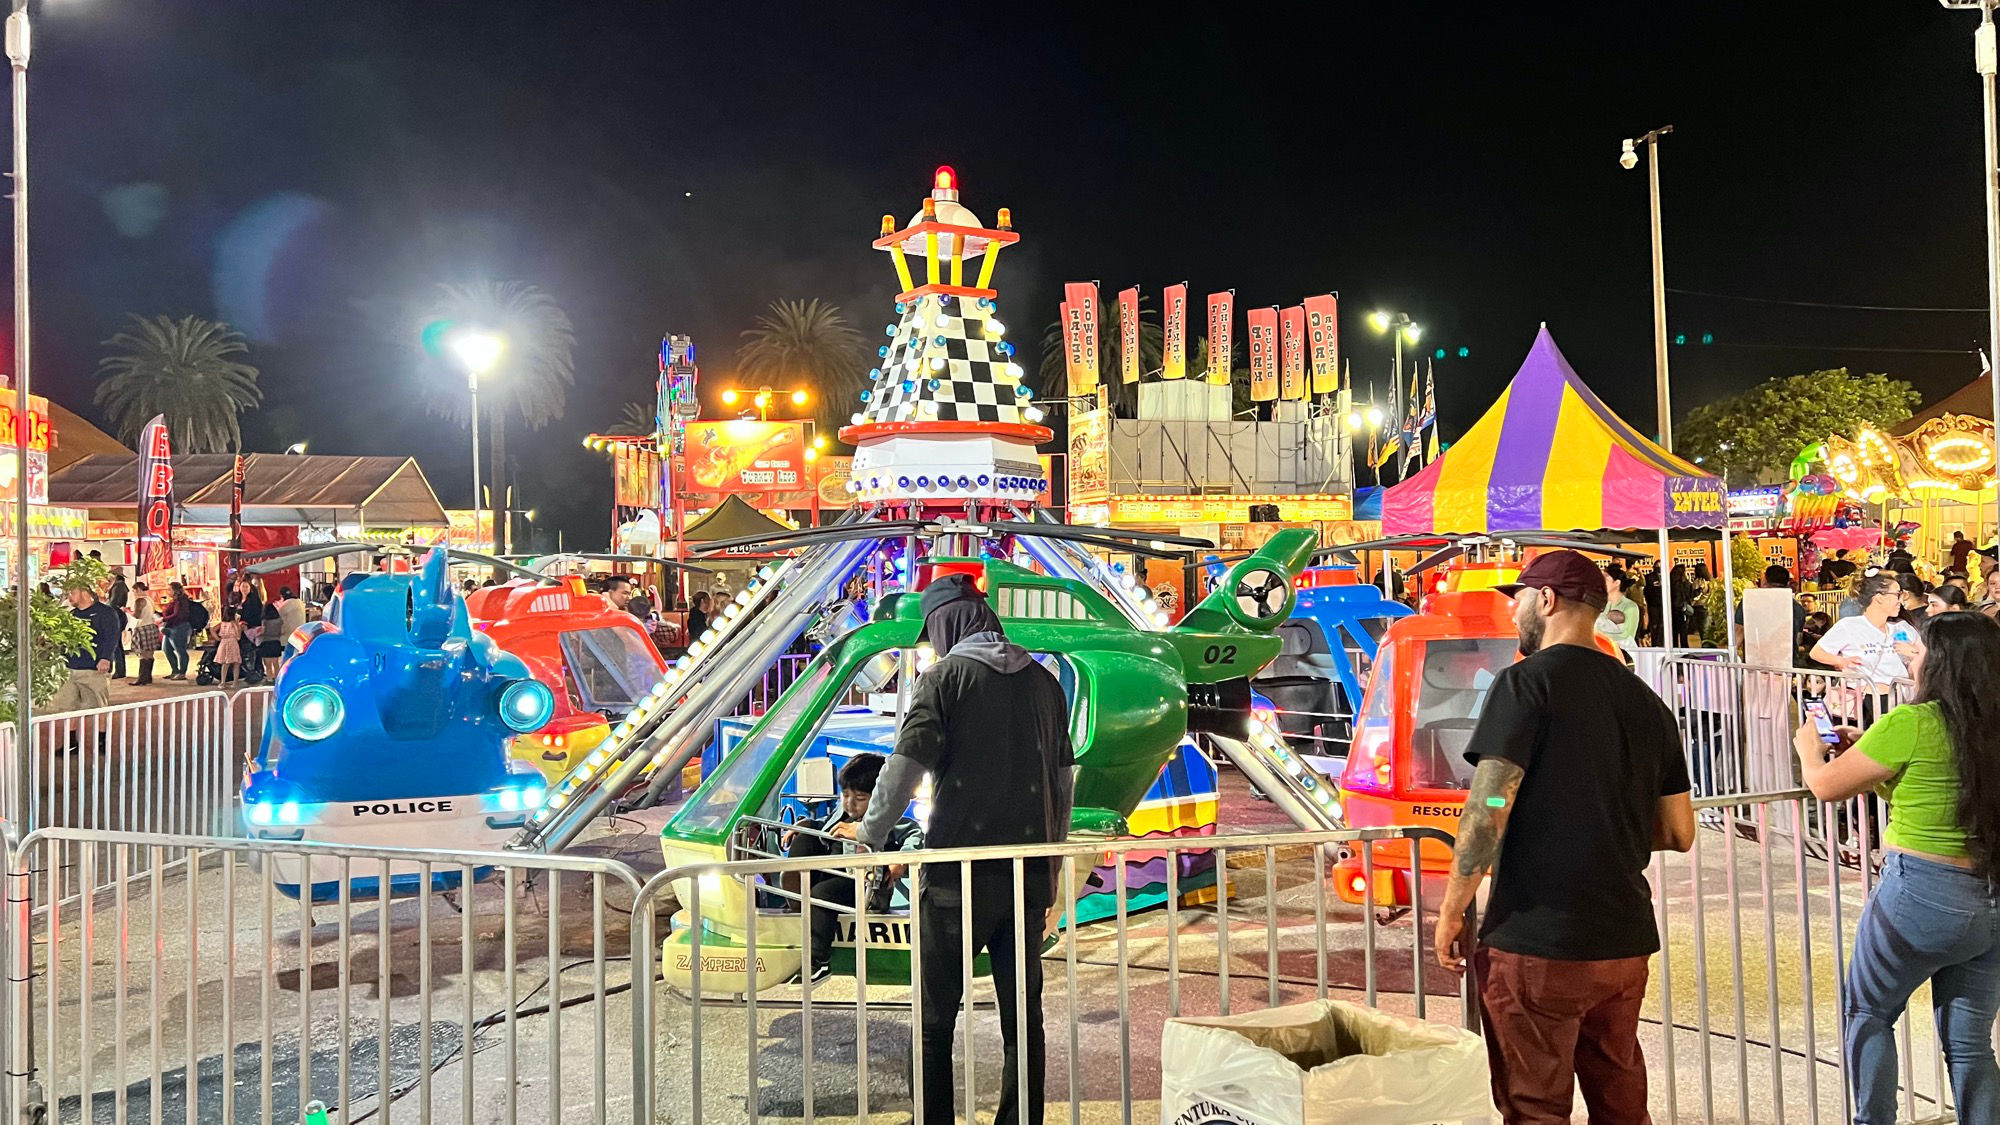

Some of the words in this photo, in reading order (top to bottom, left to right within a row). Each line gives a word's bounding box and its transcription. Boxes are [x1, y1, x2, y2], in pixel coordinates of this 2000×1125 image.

[147, 424, 174, 542] BBQ
[741, 470, 775, 484] TURKEY
[777, 470, 796, 483] LEGS
[1672, 492, 1721, 511] ENTER
[1204, 645, 1237, 664] 02
[353, 801, 452, 816] POLICE
